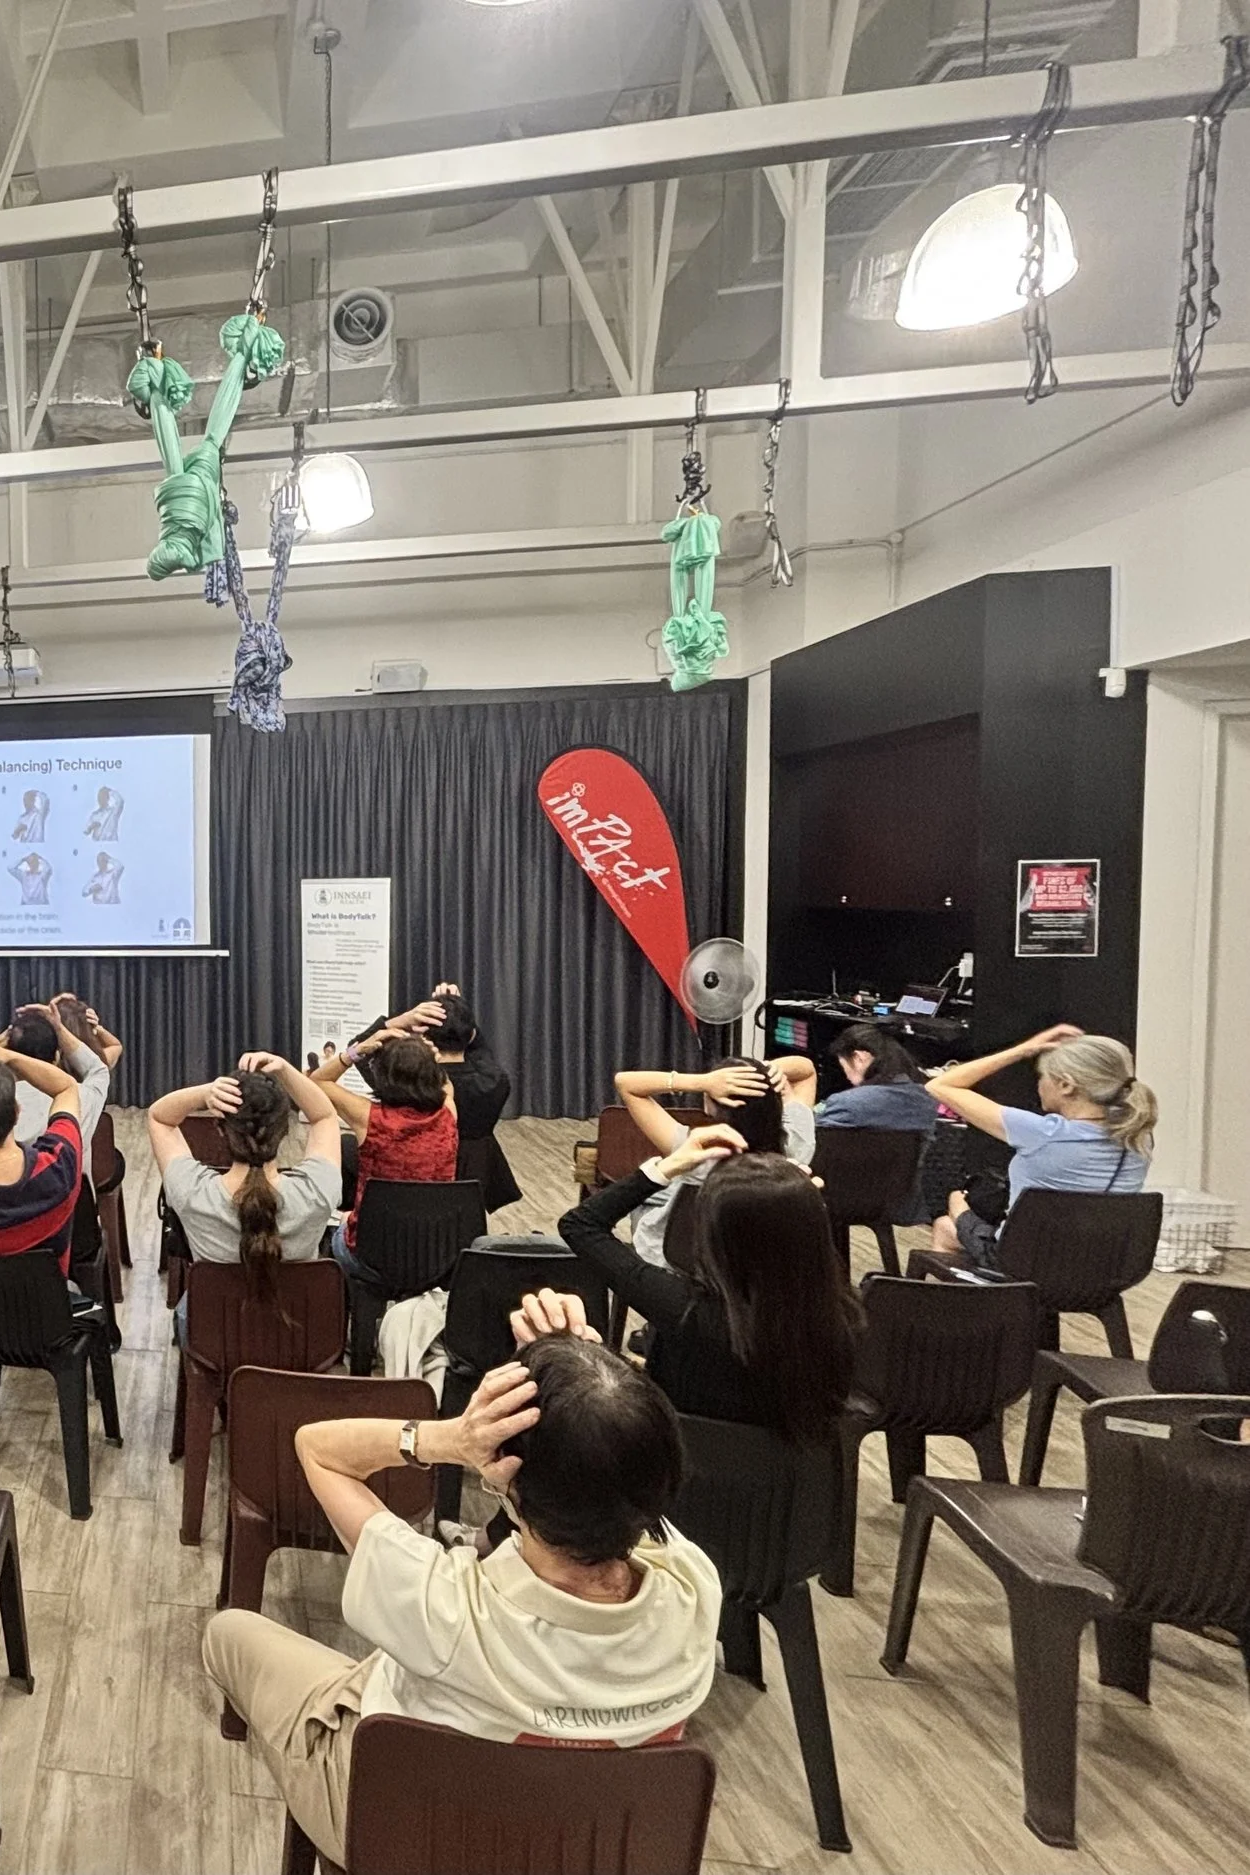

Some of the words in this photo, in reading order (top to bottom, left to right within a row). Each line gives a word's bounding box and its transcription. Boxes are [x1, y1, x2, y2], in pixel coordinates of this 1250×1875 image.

[55, 757, 123, 771] Technique
[333, 891, 372, 900] INNSAEI
[311, 912, 330, 920] What
[330, 912, 337, 920] is
[338, 912, 377, 921] BodyTalk?
